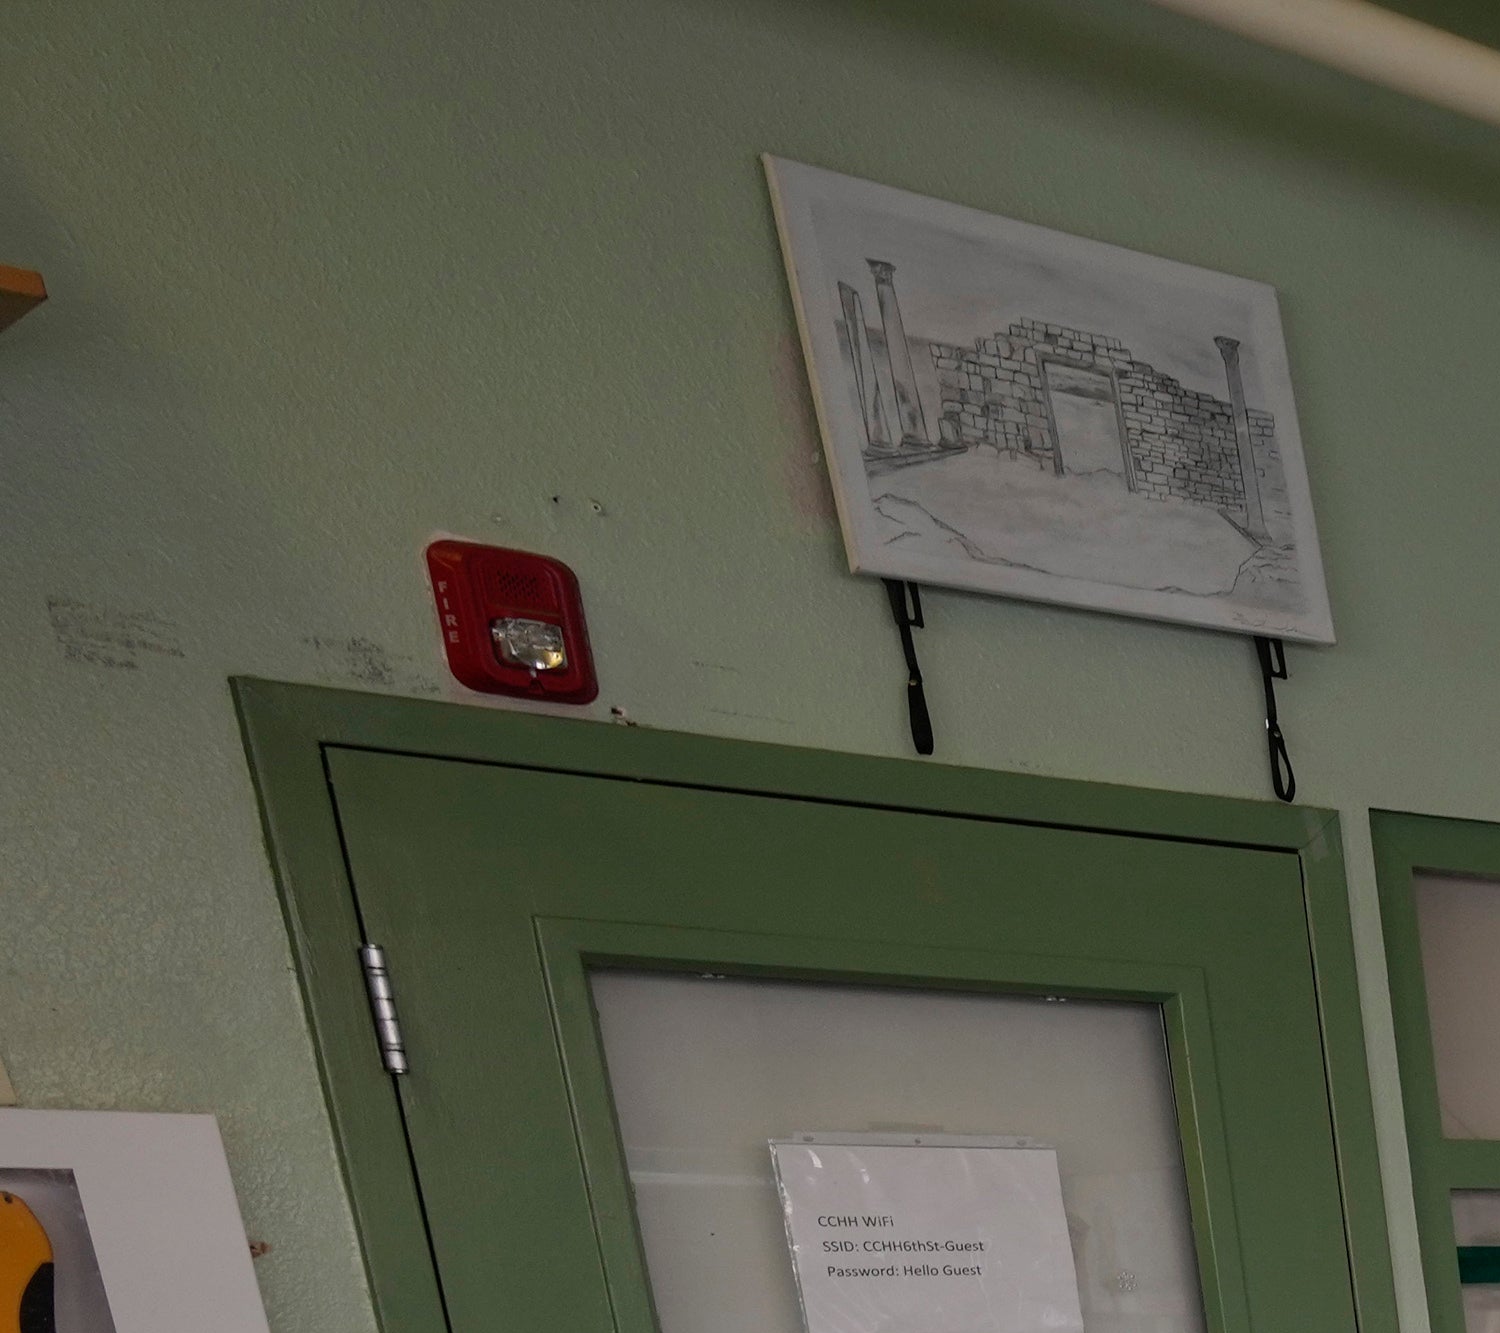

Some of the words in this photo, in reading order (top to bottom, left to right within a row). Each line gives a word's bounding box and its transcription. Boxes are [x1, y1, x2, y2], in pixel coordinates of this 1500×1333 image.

[437, 581, 460, 643] FIRE
[818, 1216, 858, 1227] CCHH
[862, 1216, 894, 1227] WiFi
[823, 1241, 859, 1252] SSID:
[863, 1240, 984, 1252] CCHH6thSt-Guest
[827, 1265, 899, 1277] Password:
[903, 1265, 938, 1276] Hello
[943, 1265, 982, 1276] Guest
